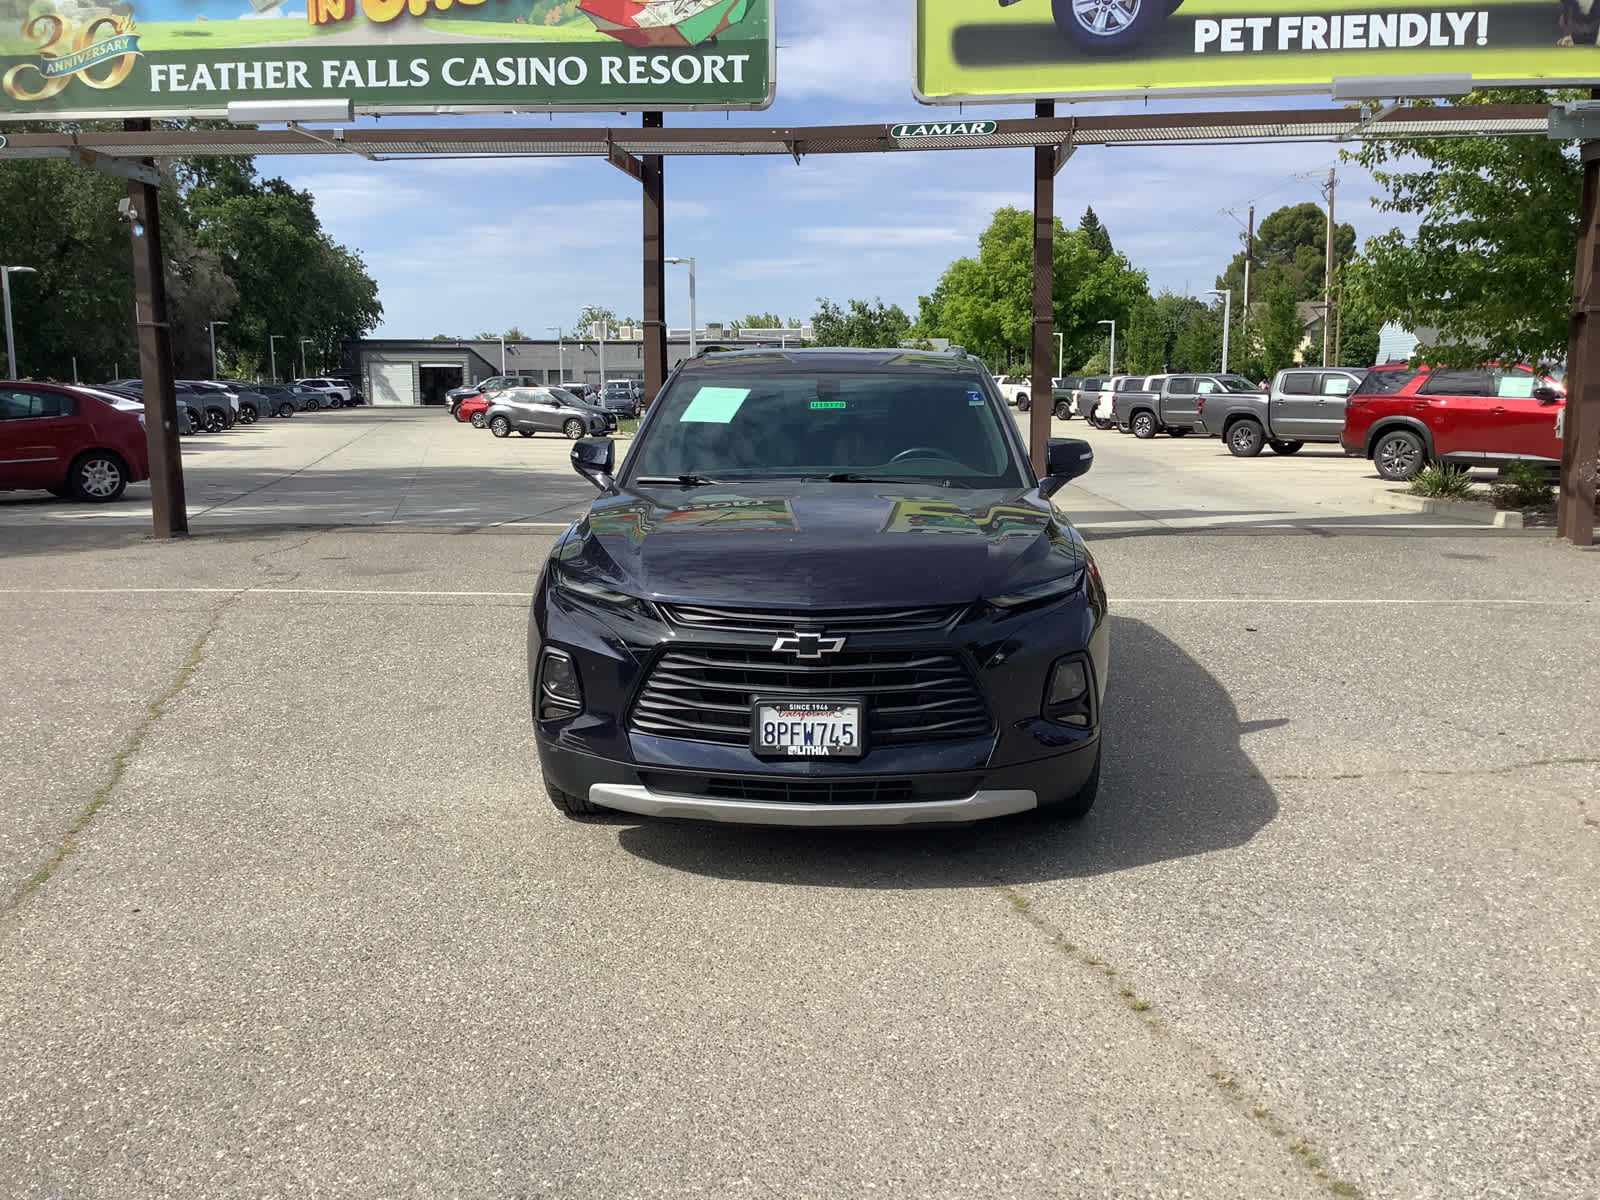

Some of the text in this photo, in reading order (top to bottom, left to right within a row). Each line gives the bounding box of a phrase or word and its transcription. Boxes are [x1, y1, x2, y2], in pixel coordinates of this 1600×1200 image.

[1194, 11, 1489, 53] PET FRIENDLY!
[46, 39, 130, 74] ANNIVERSARY
[149, 54, 750, 92] FEATHER FALLS CASINO RESORT
[900, 122, 986, 136] LAMAR
[764, 722, 854, 746] 8PFW745
[797, 745, 829, 755] LITHIA
